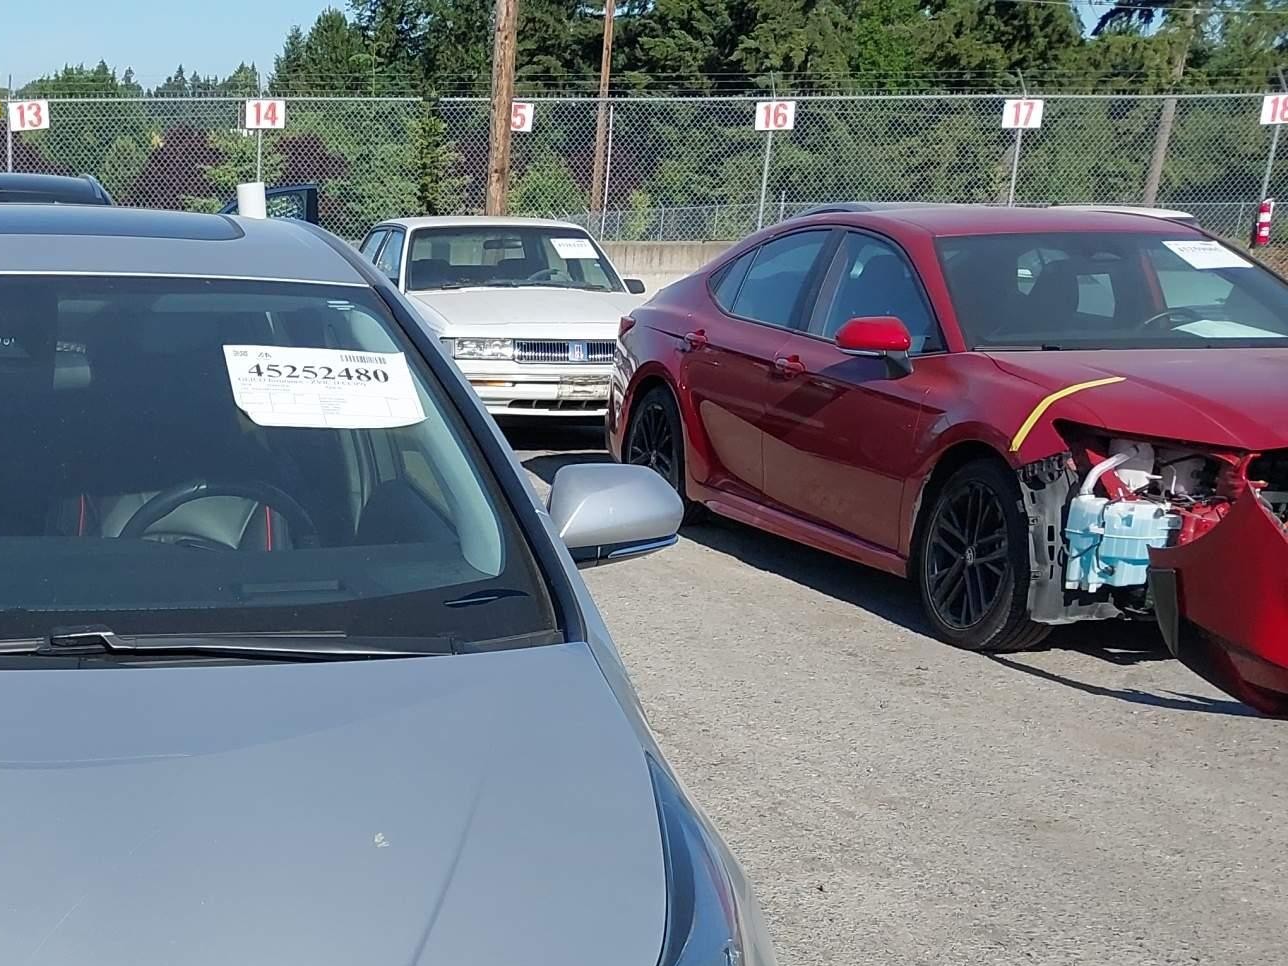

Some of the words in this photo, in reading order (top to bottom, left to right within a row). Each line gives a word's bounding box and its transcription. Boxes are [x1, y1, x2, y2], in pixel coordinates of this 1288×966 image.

[16, 103, 42, 128] 13
[253, 102, 278, 126] 14
[511, 104, 526, 129] 5
[763, 103, 787, 128] 16
[1013, 101, 1035, 126] 17
[248, 363, 389, 383] 45252480
